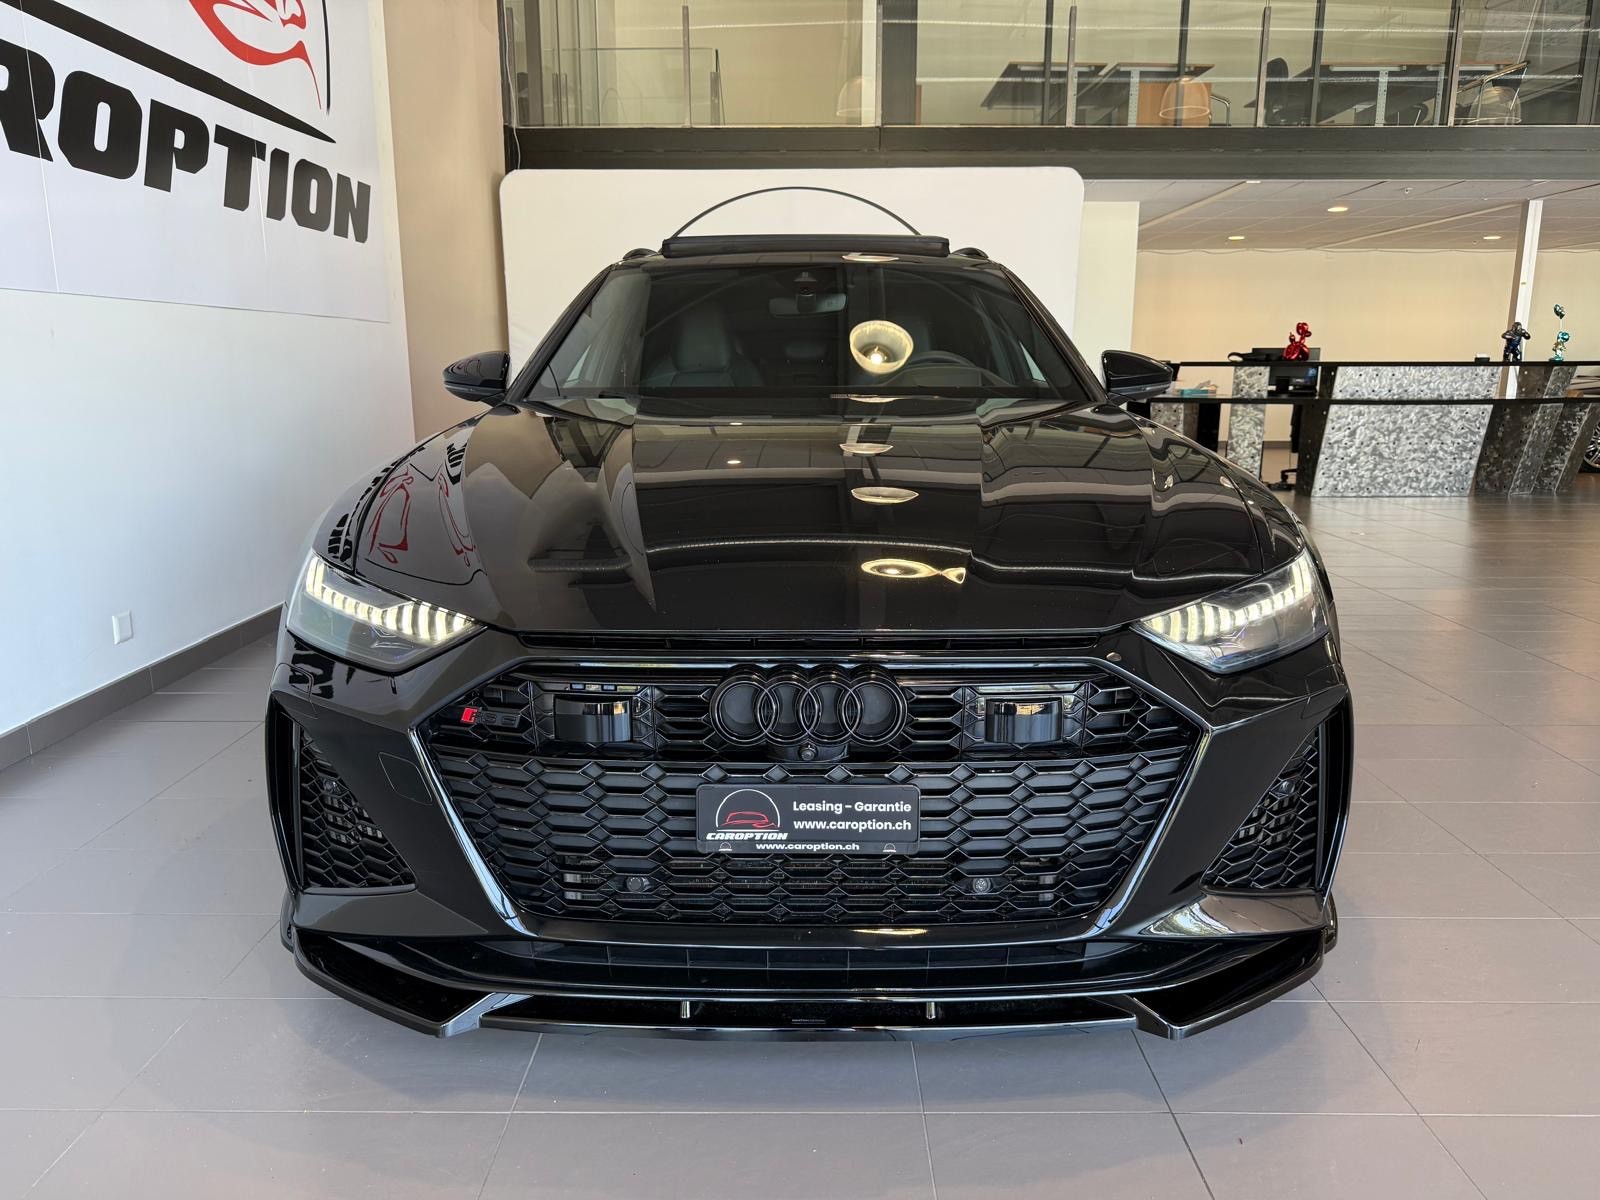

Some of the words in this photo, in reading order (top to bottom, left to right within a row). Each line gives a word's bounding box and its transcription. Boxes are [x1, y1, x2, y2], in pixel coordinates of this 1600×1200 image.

[0, 38, 371, 244] ROPTION
[792, 800, 843, 814] Leasing
[854, 801, 912, 812] Garantie
[793, 819, 912, 832] www.caroption.ch
[706, 832, 788, 840] CAROPTION
[755, 842, 860, 852] www.caroption.ch
